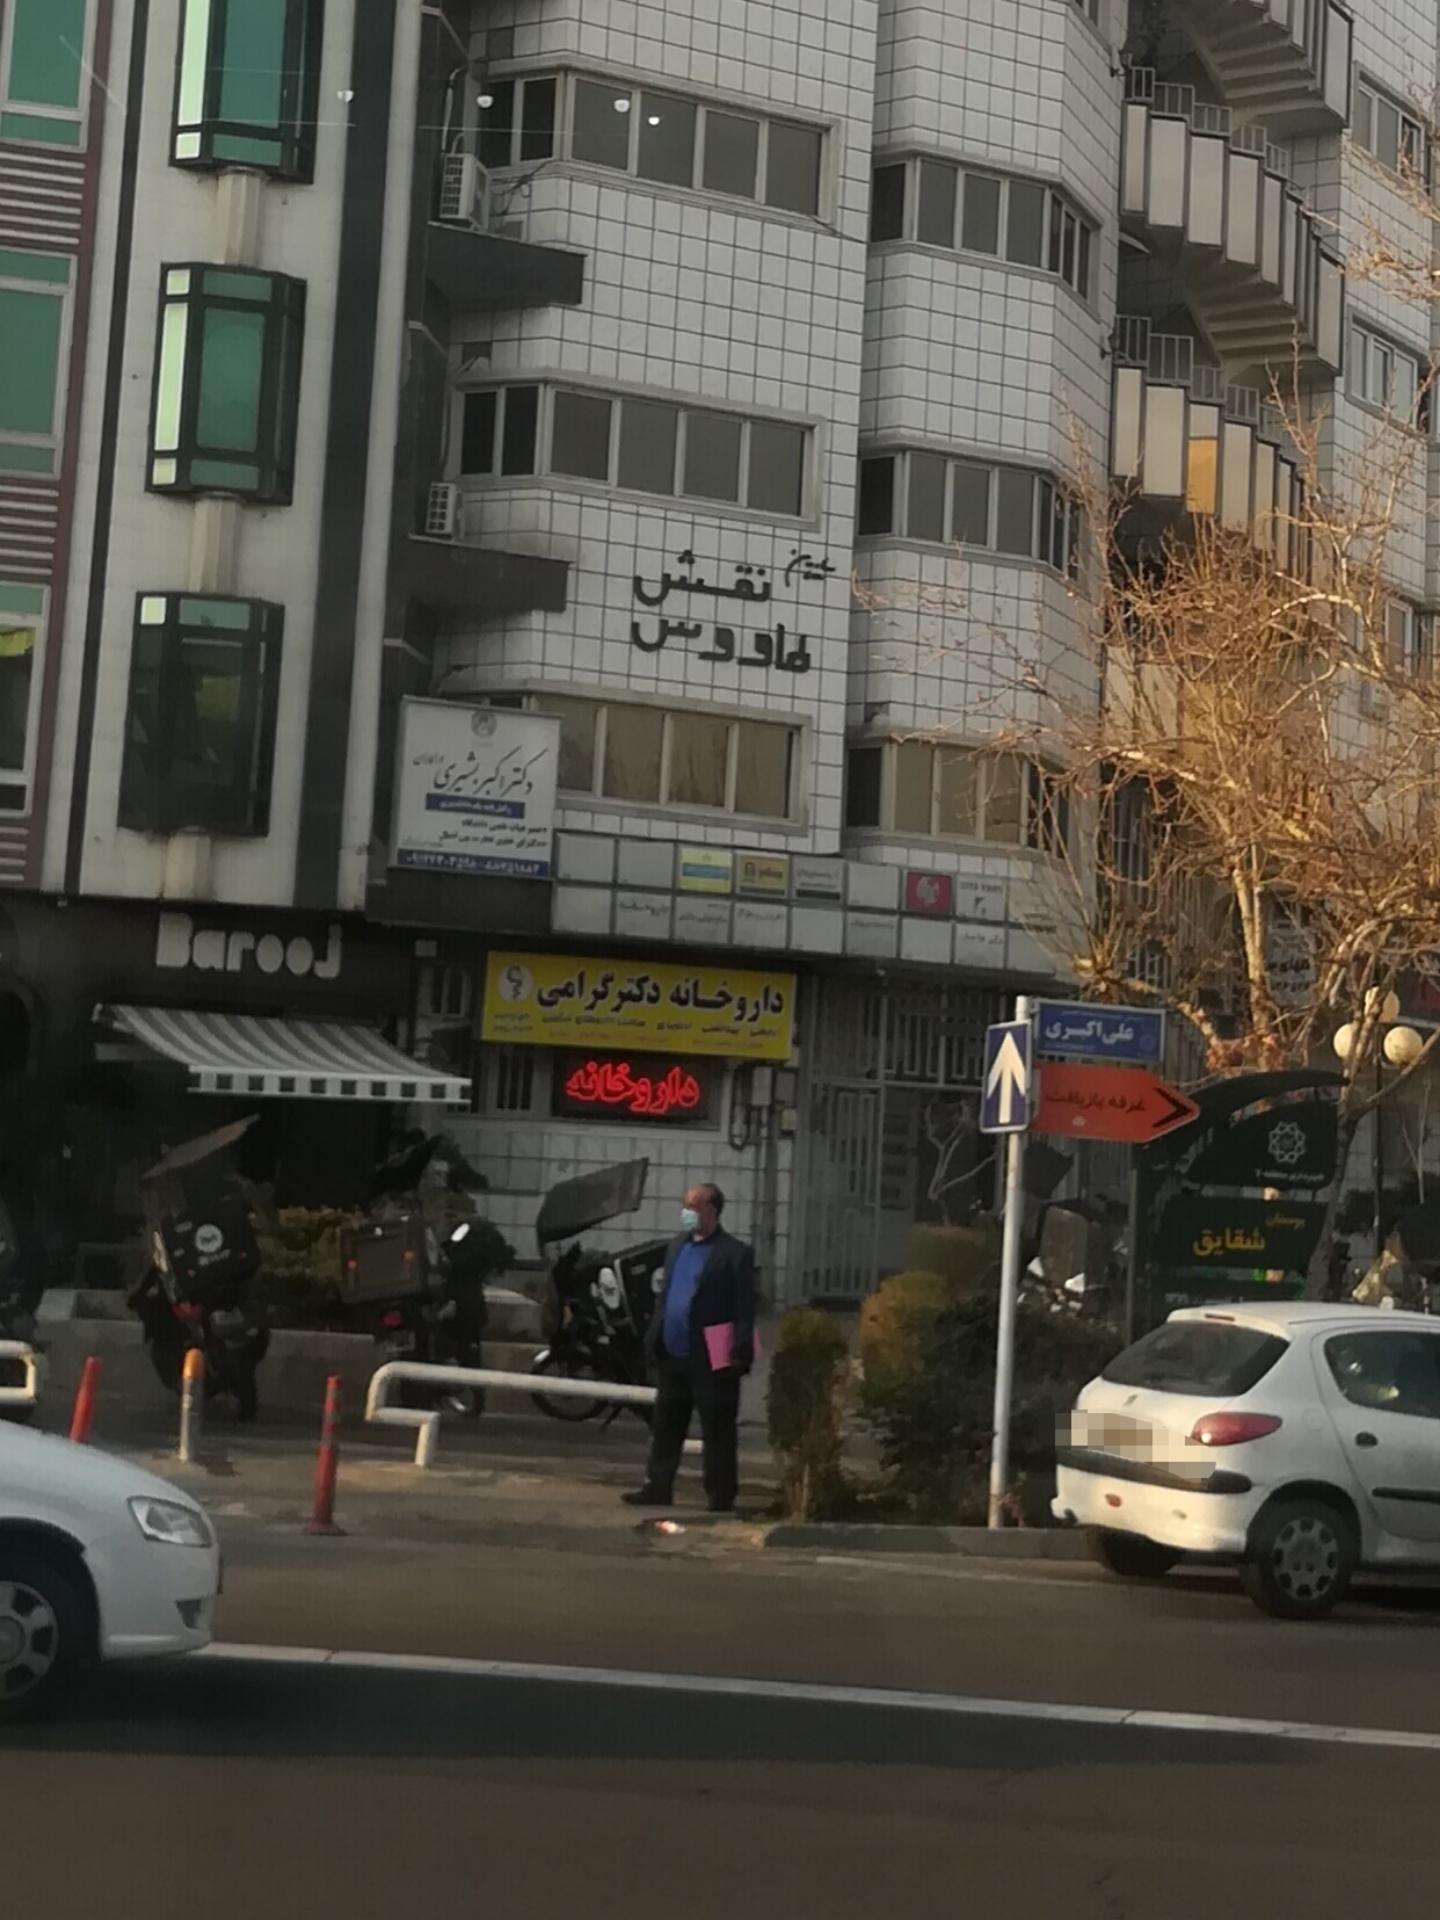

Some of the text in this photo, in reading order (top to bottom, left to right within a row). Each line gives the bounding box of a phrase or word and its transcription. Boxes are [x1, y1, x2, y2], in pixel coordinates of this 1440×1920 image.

[634, 550, 770, 607] نقش
[631, 619, 811, 673] طاووس
[500, 748, 549, 798] دکتر
[537, 970, 784, 1022] داروخانه دکتر گرامی
[1045, 1018, 1135, 1044] علی اکبری
[565, 1060, 700, 1114] داروخانه
[1193, 1226, 1266, 1257] شقایق
